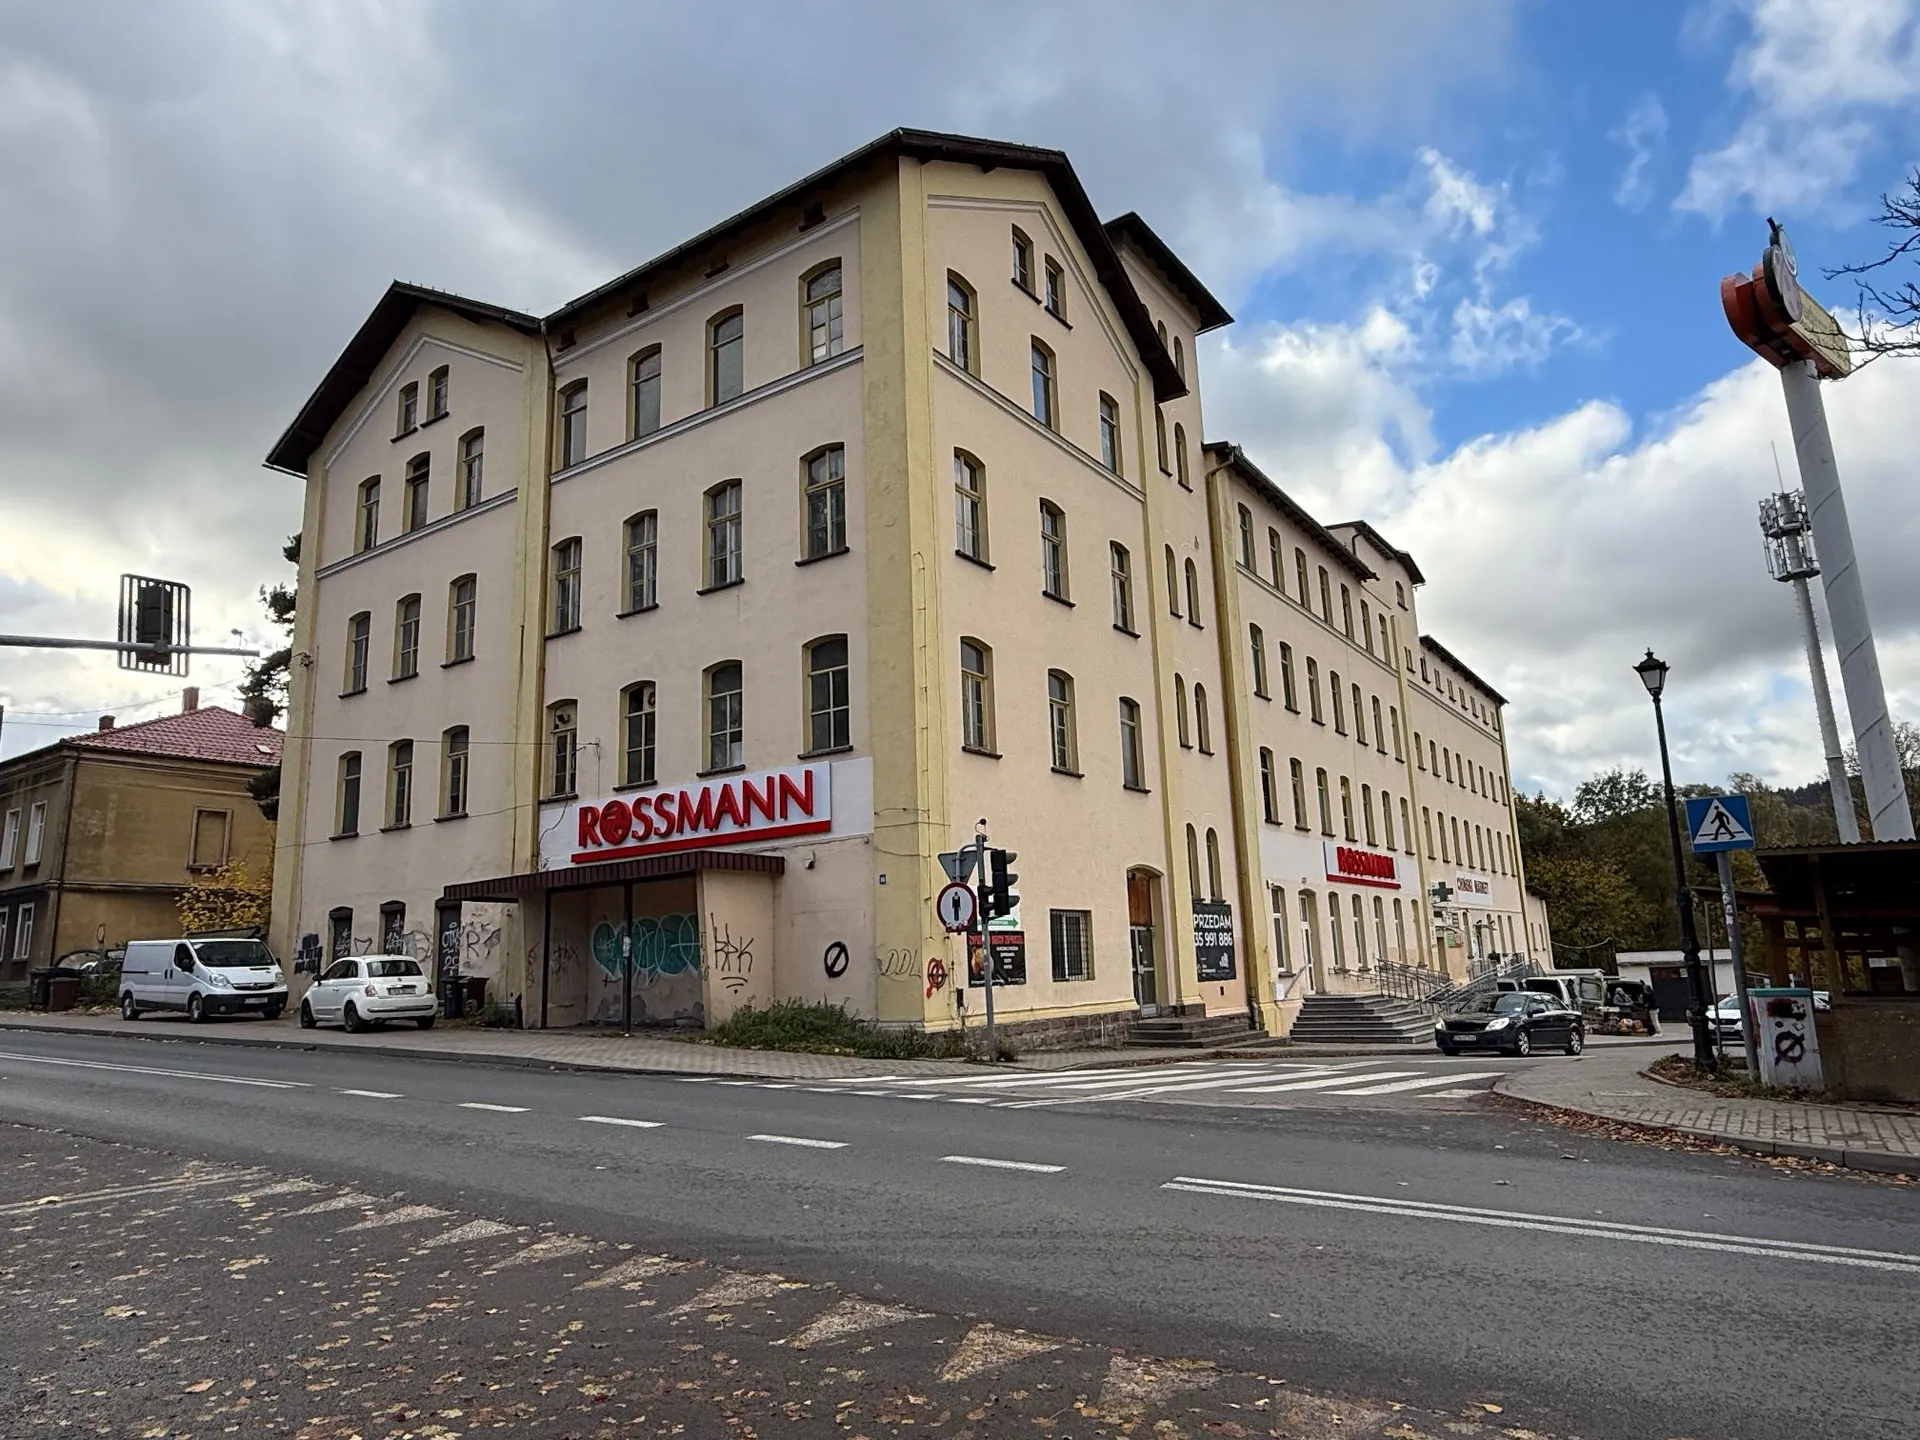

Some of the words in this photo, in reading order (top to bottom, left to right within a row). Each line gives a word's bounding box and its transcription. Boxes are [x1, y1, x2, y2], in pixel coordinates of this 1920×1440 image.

[578, 769, 814, 848] ROSSMANN
[1336, 846, 1396, 879] ROSSMANN
[1204, 932, 1218, 947] 991
[1218, 933, 1233, 947] 886
